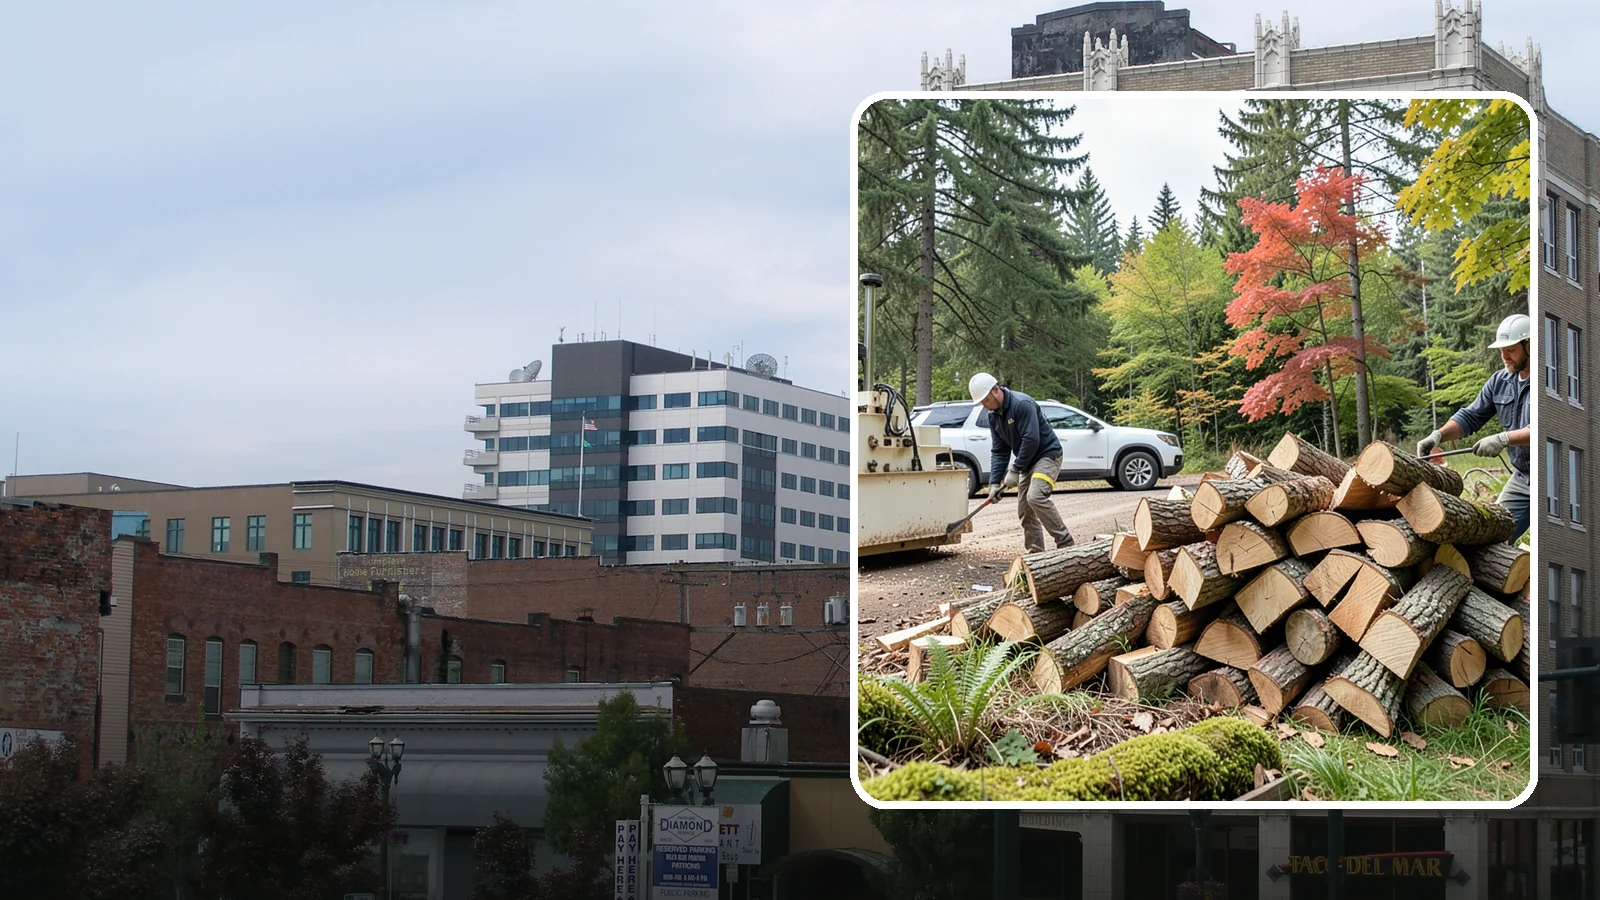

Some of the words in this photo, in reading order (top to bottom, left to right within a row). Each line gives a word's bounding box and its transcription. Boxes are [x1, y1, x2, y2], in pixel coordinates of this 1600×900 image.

[343, 567, 367, 577] Home
[370, 566, 426, 576] Furnishers
[660, 818, 713, 832] DIAMOND
[1022, 815, 1070, 828] BUILDING
[719, 824, 739, 835] ETT
[721, 852, 739, 862] Soup
[1289, 855, 1330, 874] TAC
[1346, 856, 1385, 875] DEL
[1392, 857, 1441, 877] MAR
[660, 889, 682, 897] PUBLIC
[684, 890, 710, 898] PARKING
